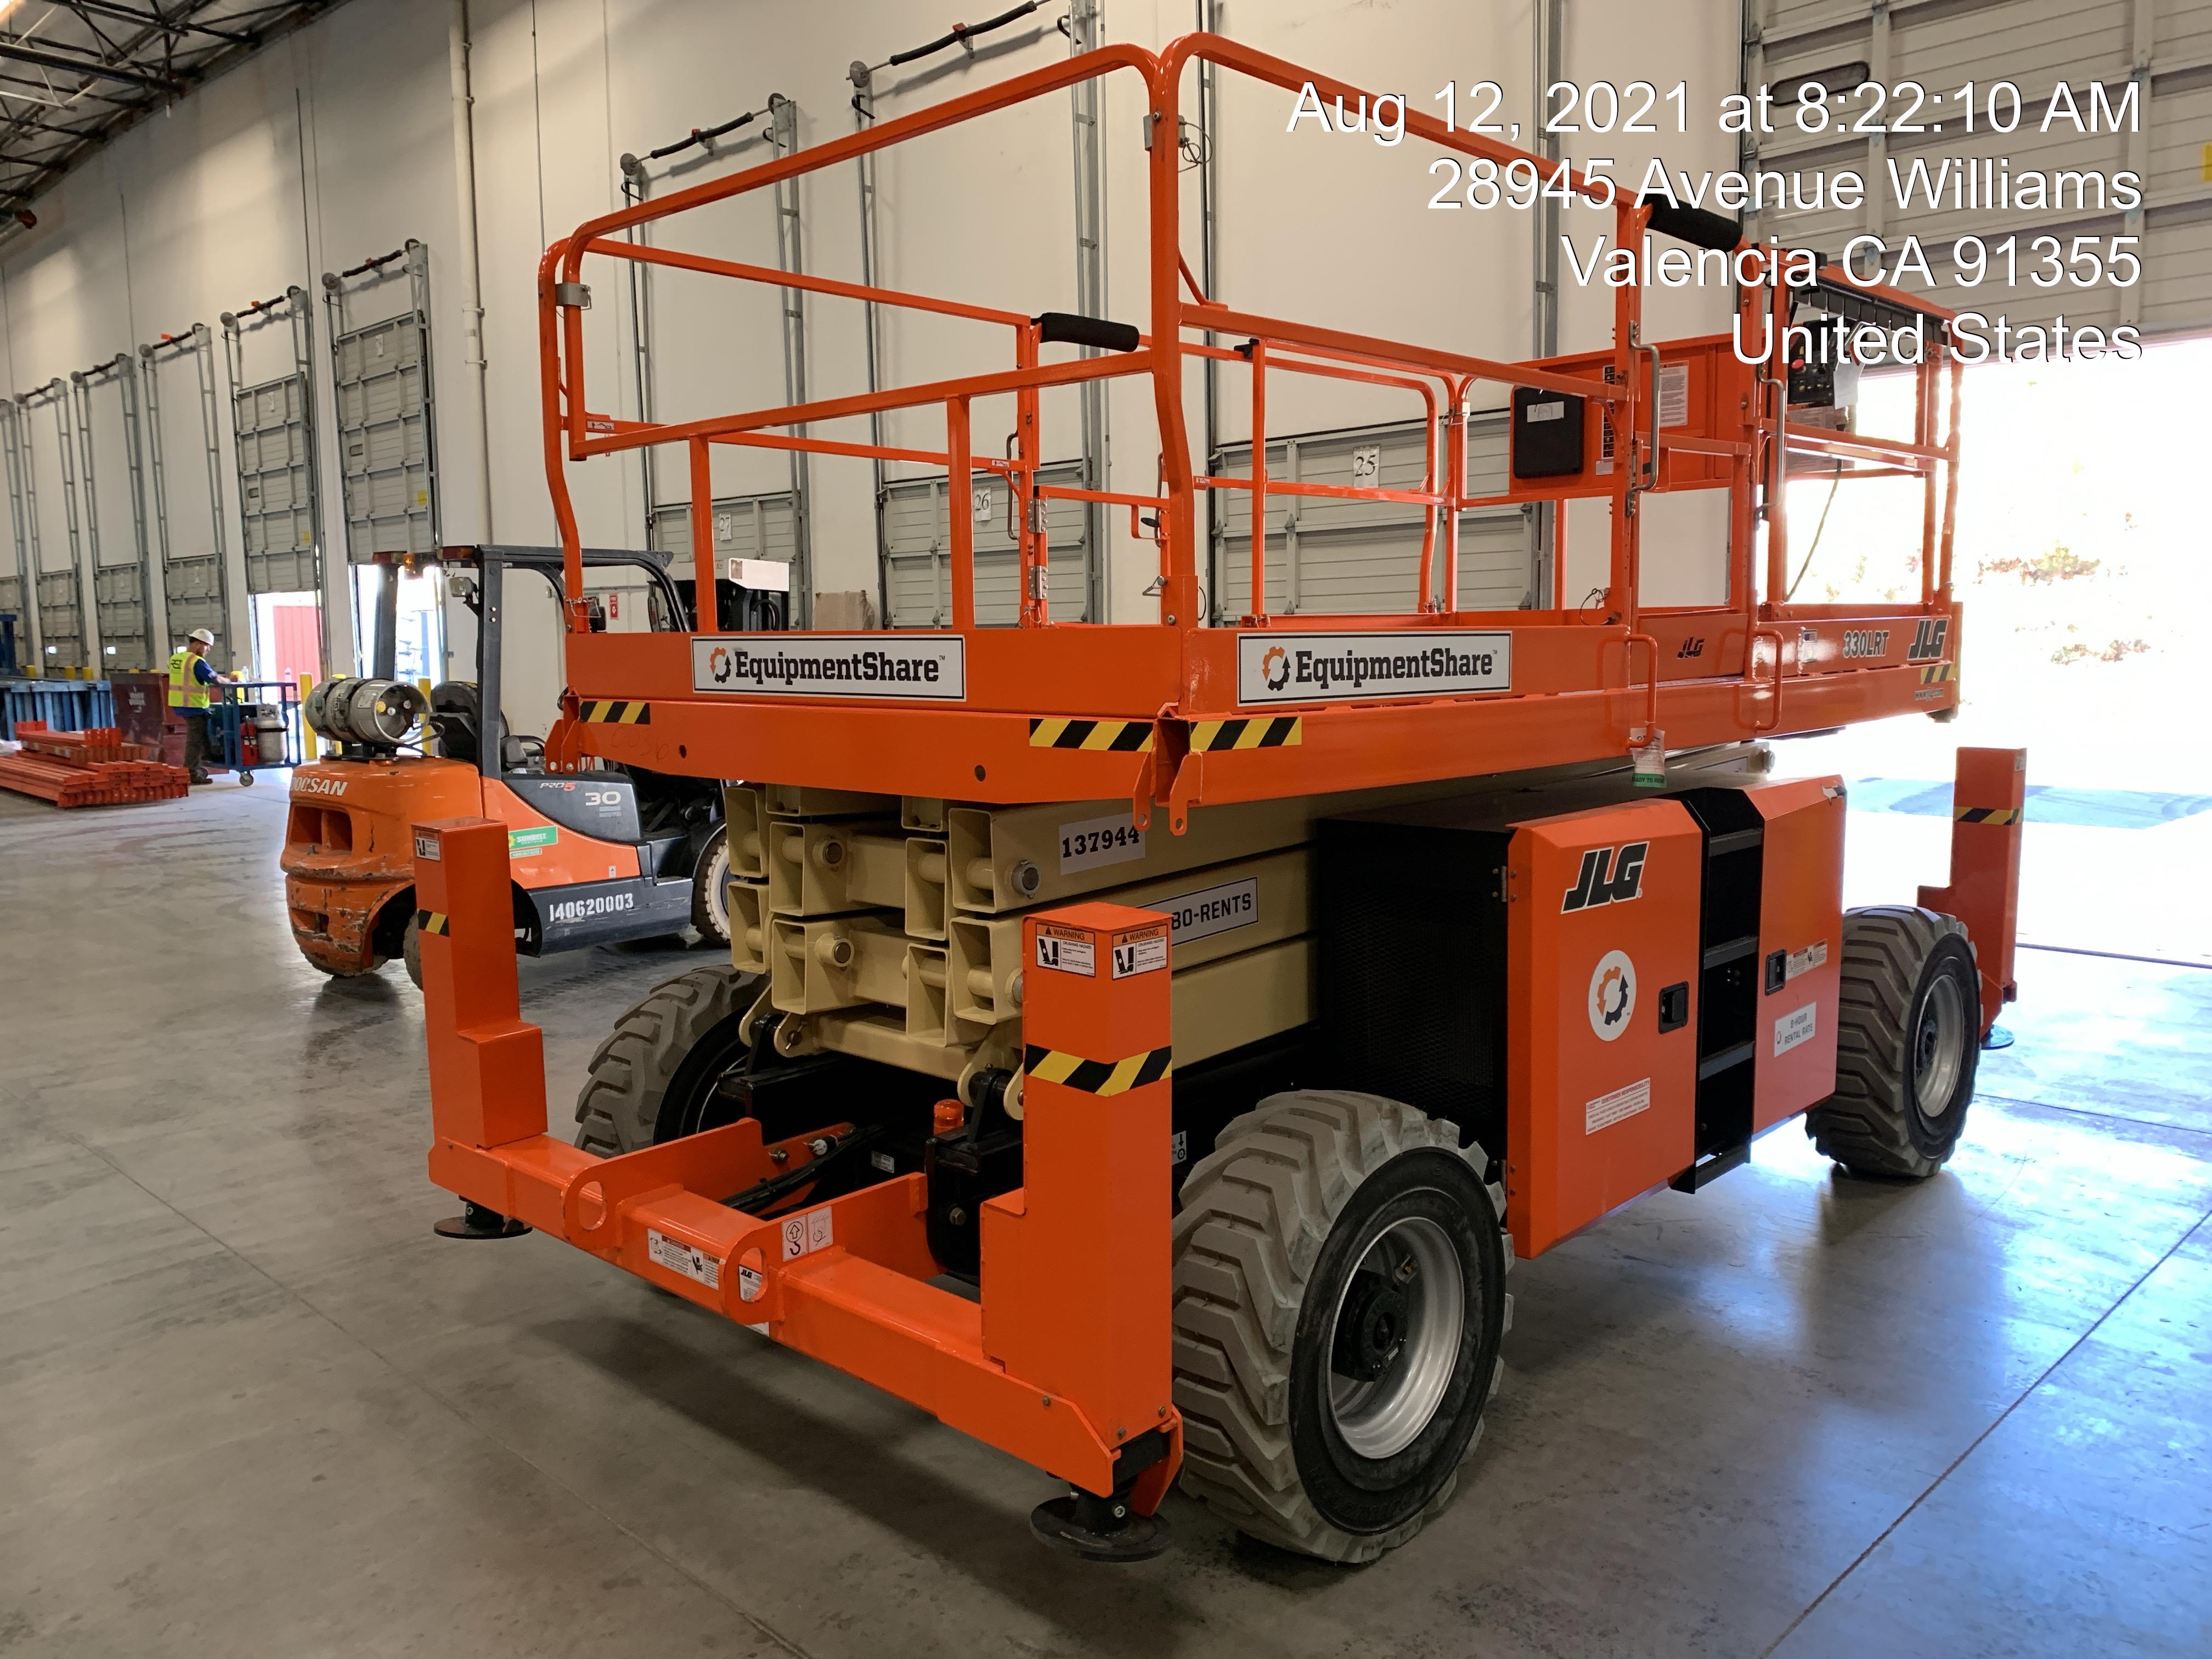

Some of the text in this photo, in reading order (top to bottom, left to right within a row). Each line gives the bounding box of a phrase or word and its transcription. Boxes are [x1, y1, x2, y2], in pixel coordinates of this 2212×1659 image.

[1355, 454, 1376, 477] 25
[975, 493, 989, 511] 26
[720, 517, 730, 532] 27
[1677, 636, 1705, 659] JLG
[1843, 630, 1890, 658] 330LRT
[1906, 619, 1948, 661] JLG
[736, 651, 939, 685] EquipmentShare
[1296, 647, 1492, 690] EquipmentShare
[585, 791, 622, 806] 30
[517, 833, 547, 843] SUNBELT
[1062, 825, 1139, 858] 137944
[1560, 841, 1650, 915] JLG
[550, 893, 634, 922] 140620003
[1053, 928, 1085, 941] WARNING
[1129, 928, 1159, 941] WARNING
[1791, 1013, 1808, 1029] 8-HOUR
[1785, 1023, 1813, 1045] RENTAL RATE
[741, 1269, 753, 1279] JLG
